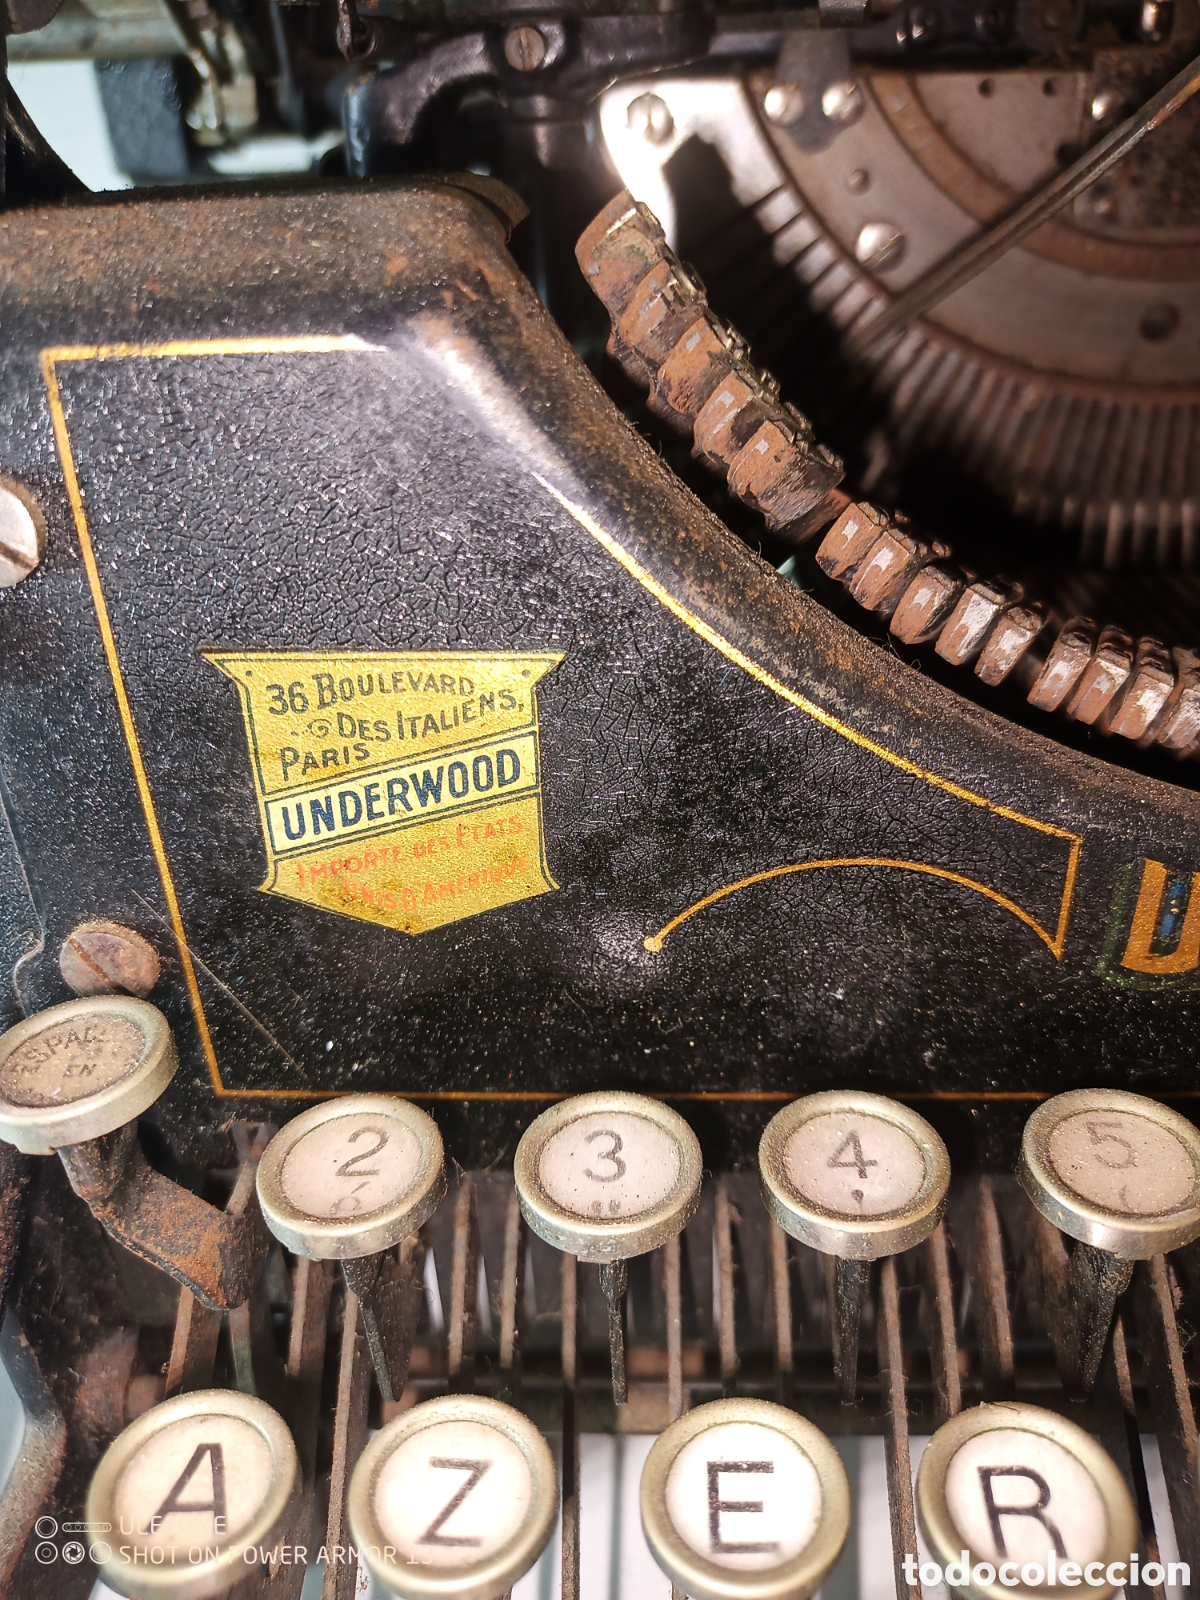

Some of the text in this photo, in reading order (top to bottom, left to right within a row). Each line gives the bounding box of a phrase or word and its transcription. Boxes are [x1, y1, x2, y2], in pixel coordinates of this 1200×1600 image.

[266, 672, 475, 716] 36 BOULEVARD
[337, 712, 391, 742] DES
[280, 742, 370, 781] PARIS
[282, 748, 521, 841] UNDERWOOD
[335, 1126, 390, 1177] 2
[582, 1129, 627, 1182] 3
[827, 1129, 878, 1179] 4
[1083, 1122, 1139, 1169] 5
[145, 1442, 230, 1535] A
[415, 1456, 494, 1548] Z
[707, 1460, 780, 1554] E
[977, 1465, 1069, 1559] R
